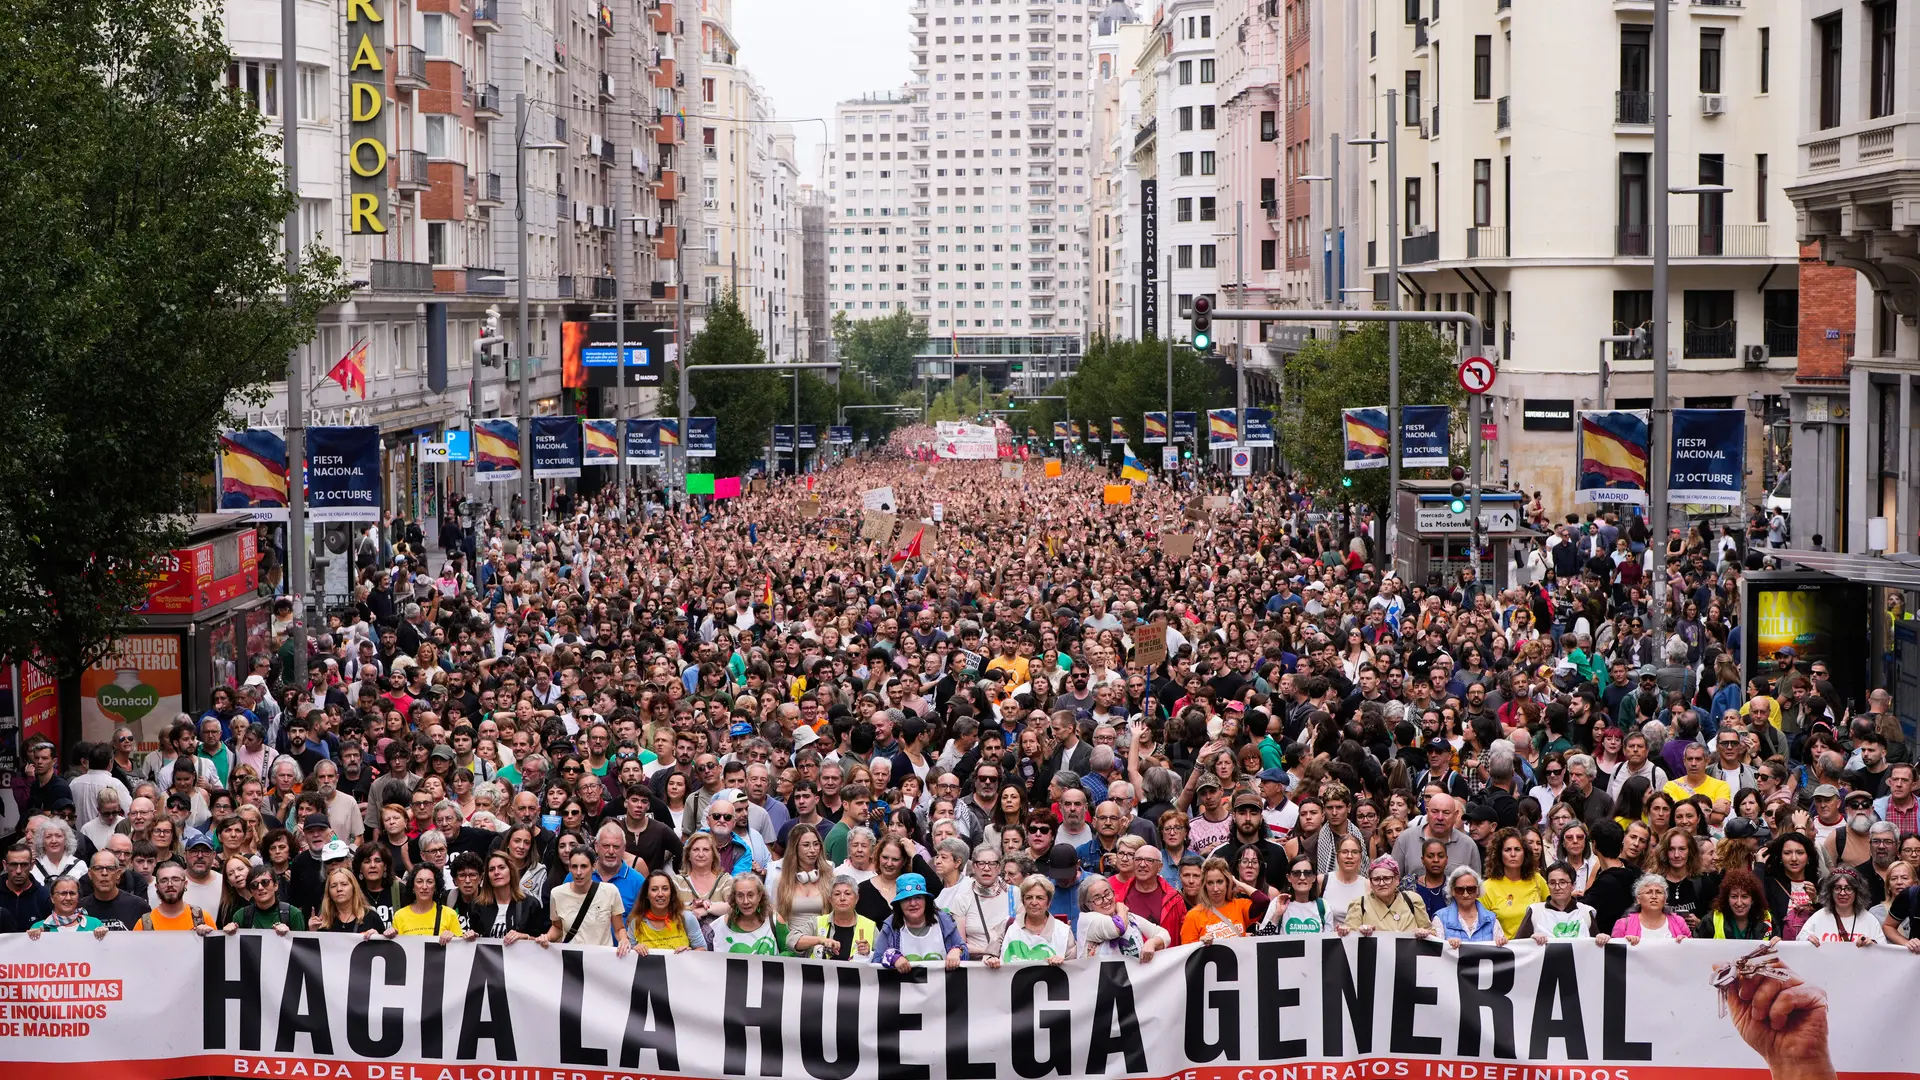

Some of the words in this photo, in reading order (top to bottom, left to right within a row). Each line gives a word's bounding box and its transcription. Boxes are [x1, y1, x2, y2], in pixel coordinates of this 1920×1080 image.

[1146, 186, 1154, 262] CATALONIA
[1146, 269, 1154, 312] PLAZA
[1677, 438, 1706, 448] FIESTA
[313, 455, 343, 465] FIESTA
[1676, 450, 1725, 459] NACIONAL
[313, 467, 363, 476] NACIONAL
[1675, 473, 1685, 482] 12
[1686, 473, 1733, 486] OCTUBRE
[314, 490, 325, 500] 12
[328, 490, 373, 501] OCTUBRE
[1598, 492, 1629, 501] MADRID
[115, 638, 178, 654] REDUCIR
[102, 695, 152, 706] Danacol
[24, 717, 33, 728] HOP
[42, 709, 50, 720] HOP
[1193, 836, 1218, 851] HELLO
[1289, 922, 1316, 930] SANIDAD
[0, 962, 91, 979] SINDICATO
[0, 986, 18, 1000] DE
[21, 983, 119, 1000] INQUILINAS
[11, 1004, 107, 1020] INQUILINOS
[203, 935, 517, 1061] HACIA
[559, 949, 680, 1072] LA
[723, 959, 1148, 1080] HUELGA
[1184, 937, 1652, 1062] GENERAL
[0, 1022, 19, 1037] DE
[23, 1022, 90, 1037] MADRID
[234, 1058, 352, 1078] BAJADA
[368, 1065, 422, 1080] DEL
[1238, 1061, 1409, 1080] CONTRATOS
[1425, 1063, 1629, 1080] INDEFINIDOS
